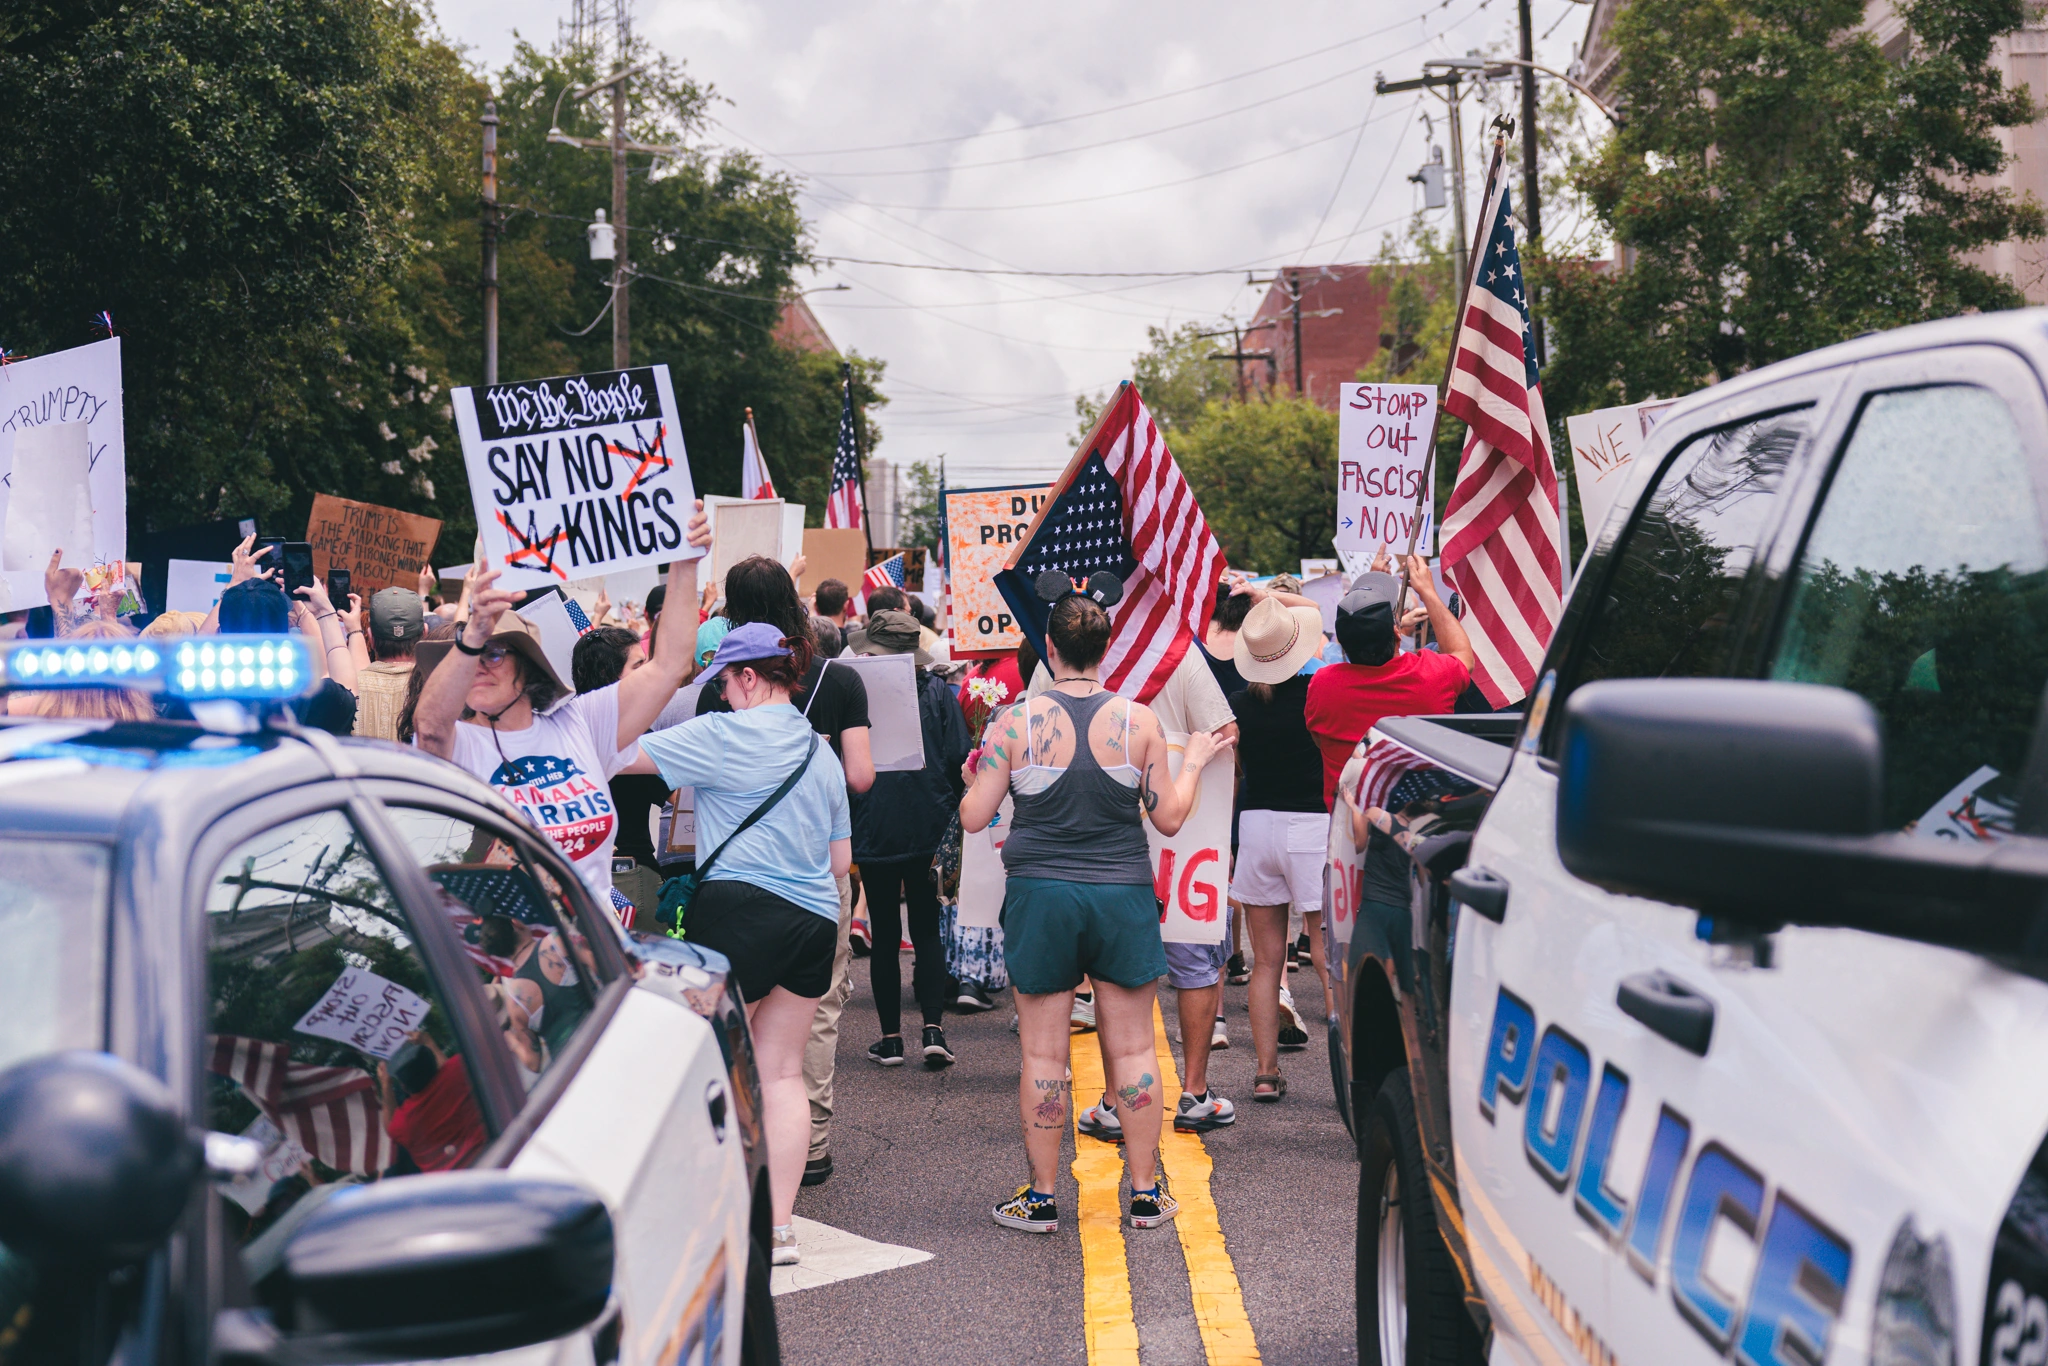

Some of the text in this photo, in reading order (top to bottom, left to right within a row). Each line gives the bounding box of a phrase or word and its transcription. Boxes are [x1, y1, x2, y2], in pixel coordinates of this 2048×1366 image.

[487, 373, 648, 433] We the People
[1575, 423, 1631, 472] WE
[488, 433, 613, 506] SAY NO
[343, 505, 399, 535] TRUMP IS
[1011, 495, 1046, 516] DU
[321, 520, 345, 540] THE
[402, 539, 426, 557] THAT
[561, 488, 682, 567] KINGS
[980, 523, 1029, 544] PRO
[329, 556, 348, 569] US
[353, 561, 398, 584] ABOUT
[354, 544, 397, 567] THRONES
[978, 614, 1024, 635] OP
[500, 777, 599, 805] AMALA
[546, 771, 565, 782] HER
[521, 792, 611, 826] ARRIS
[566, 821, 607, 837] PEOPLE
[1479, 982, 1854, 1366] POLICE
